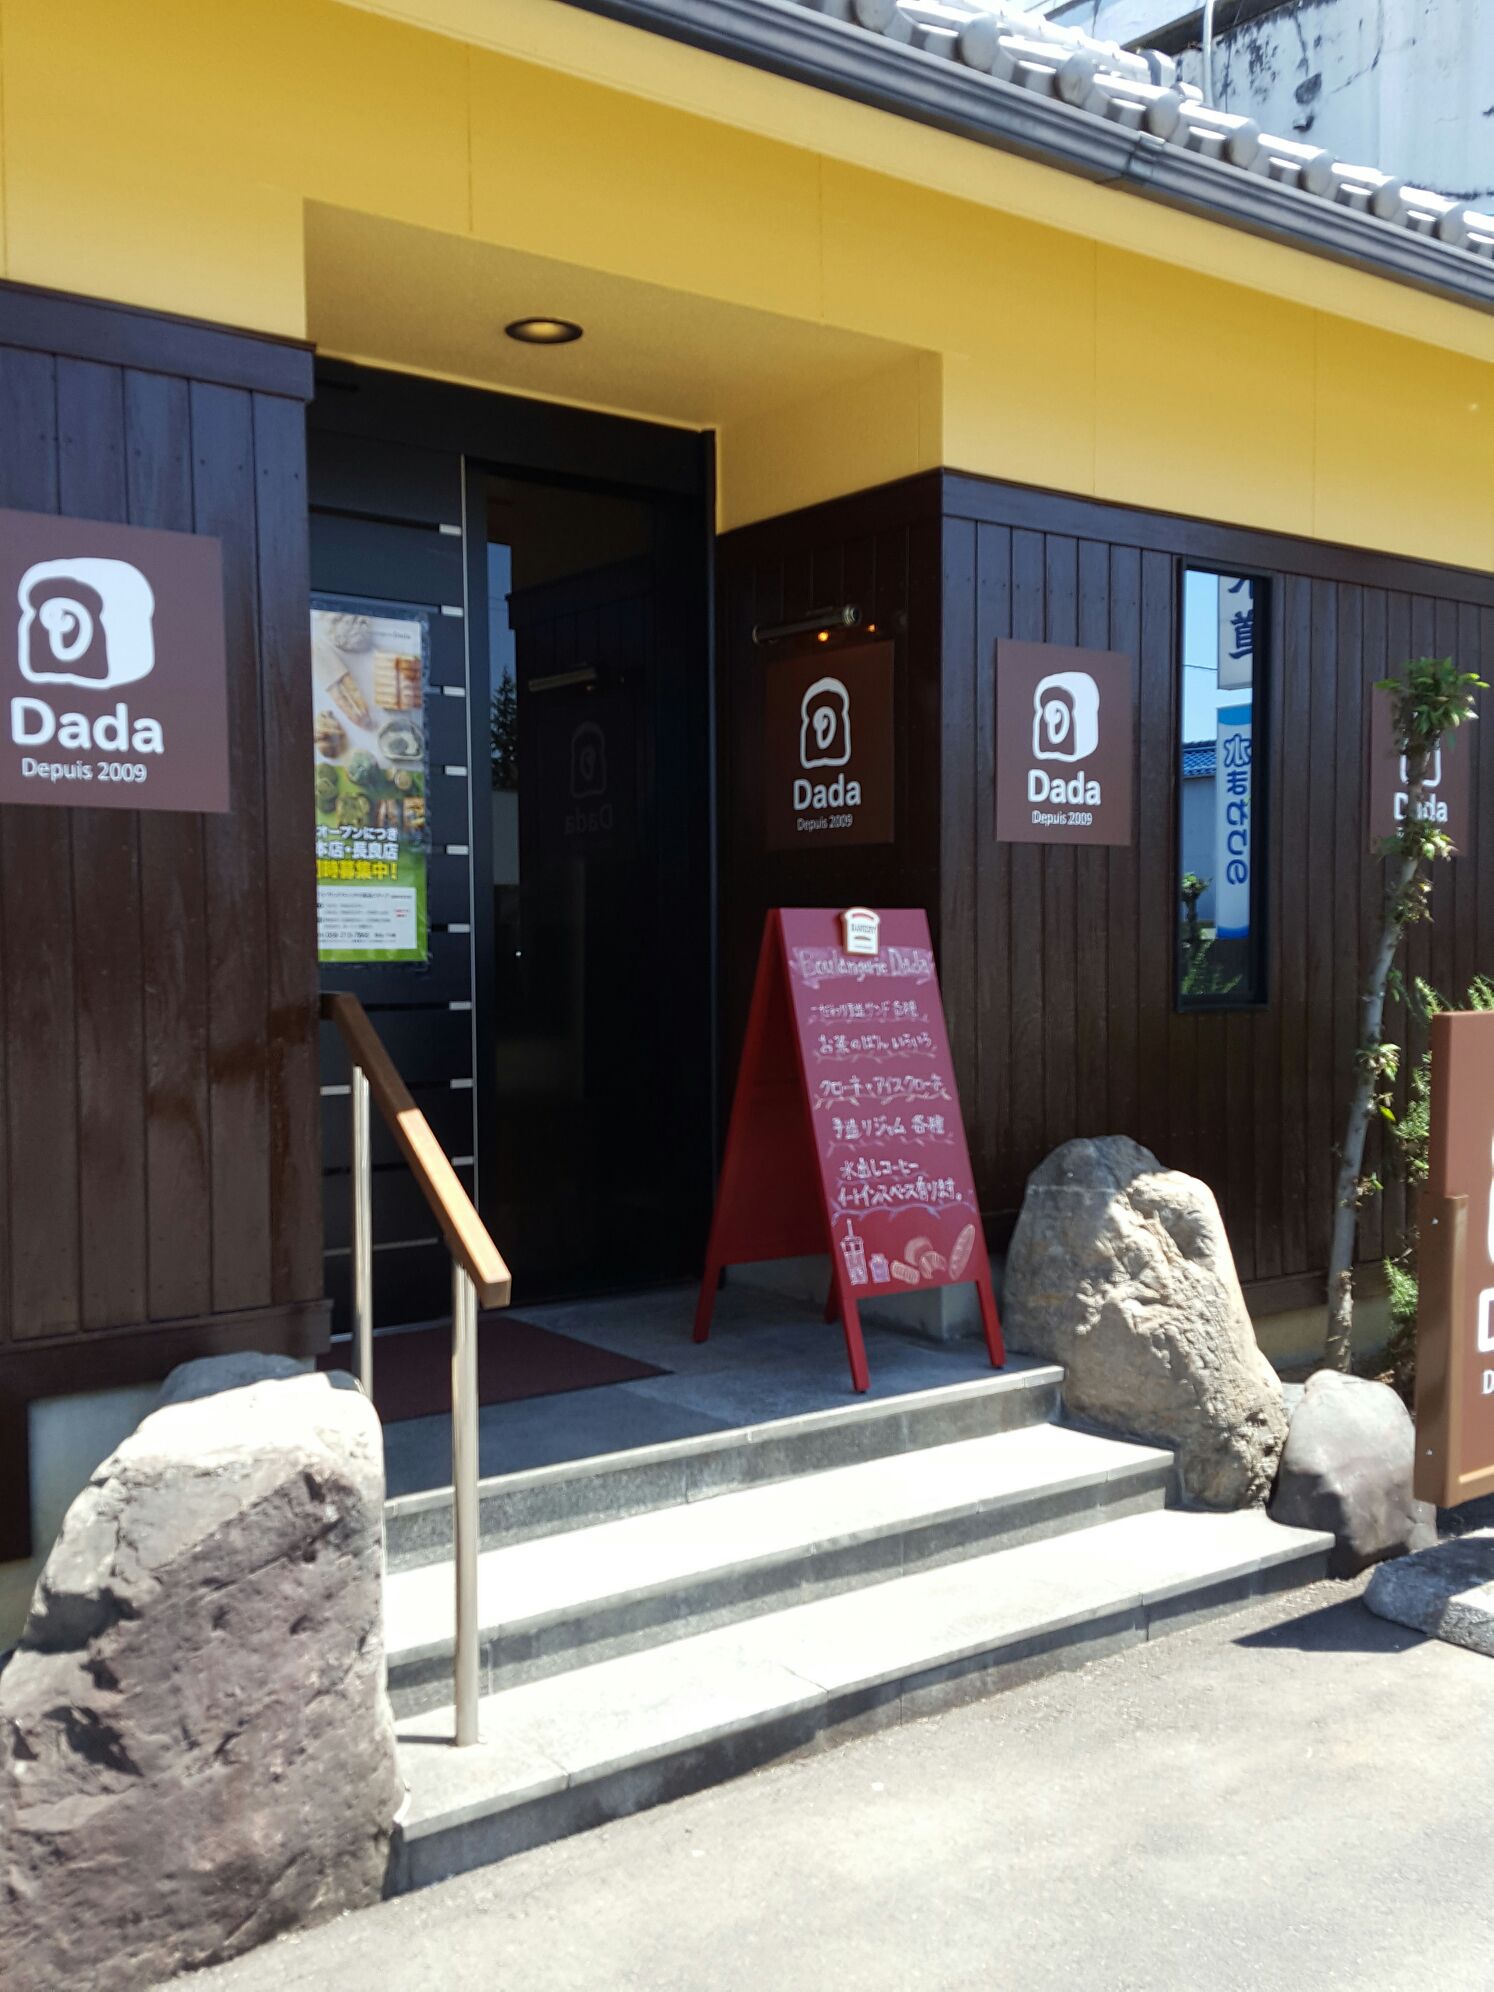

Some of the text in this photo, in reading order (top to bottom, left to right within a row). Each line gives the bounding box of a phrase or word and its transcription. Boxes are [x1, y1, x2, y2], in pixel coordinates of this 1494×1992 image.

[11, 696, 164, 754] Dada
[22, 757, 148, 783] Depuis 2009
[793, 772, 861, 811] Dada
[1027, 768, 1101, 806] Dada
[797, 813, 853, 832] Depuis 2009
[1032, 810, 1093, 827] Depuis 2009
